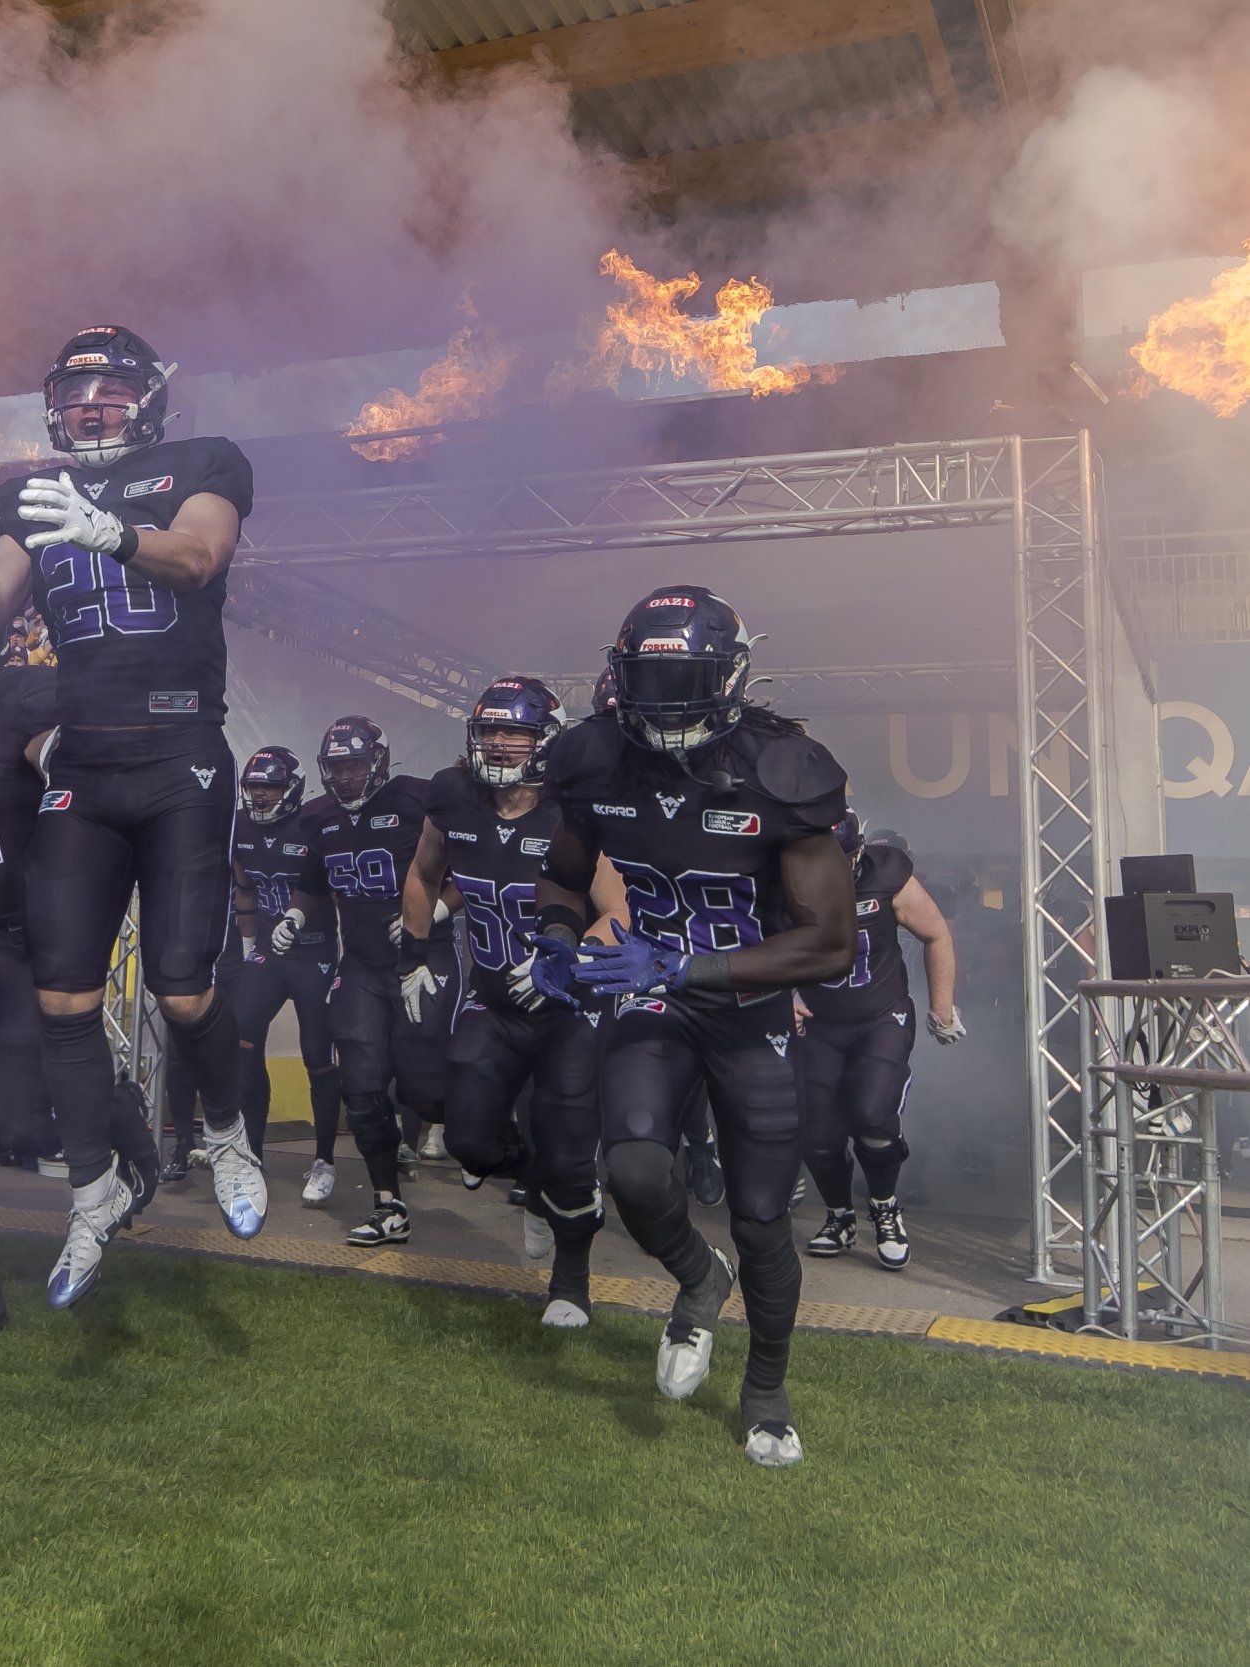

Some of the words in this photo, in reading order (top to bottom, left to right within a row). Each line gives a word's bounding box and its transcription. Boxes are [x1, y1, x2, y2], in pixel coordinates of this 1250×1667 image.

[69, 356, 104, 365] FORELLE
[40, 524, 178, 648] 20
[649, 597, 691, 608] GAZI
[642, 643, 684, 651] FORELLE
[493, 682, 520, 690] GAZI
[325, 848, 401, 899] 59
[607, 856, 765, 956] 28
